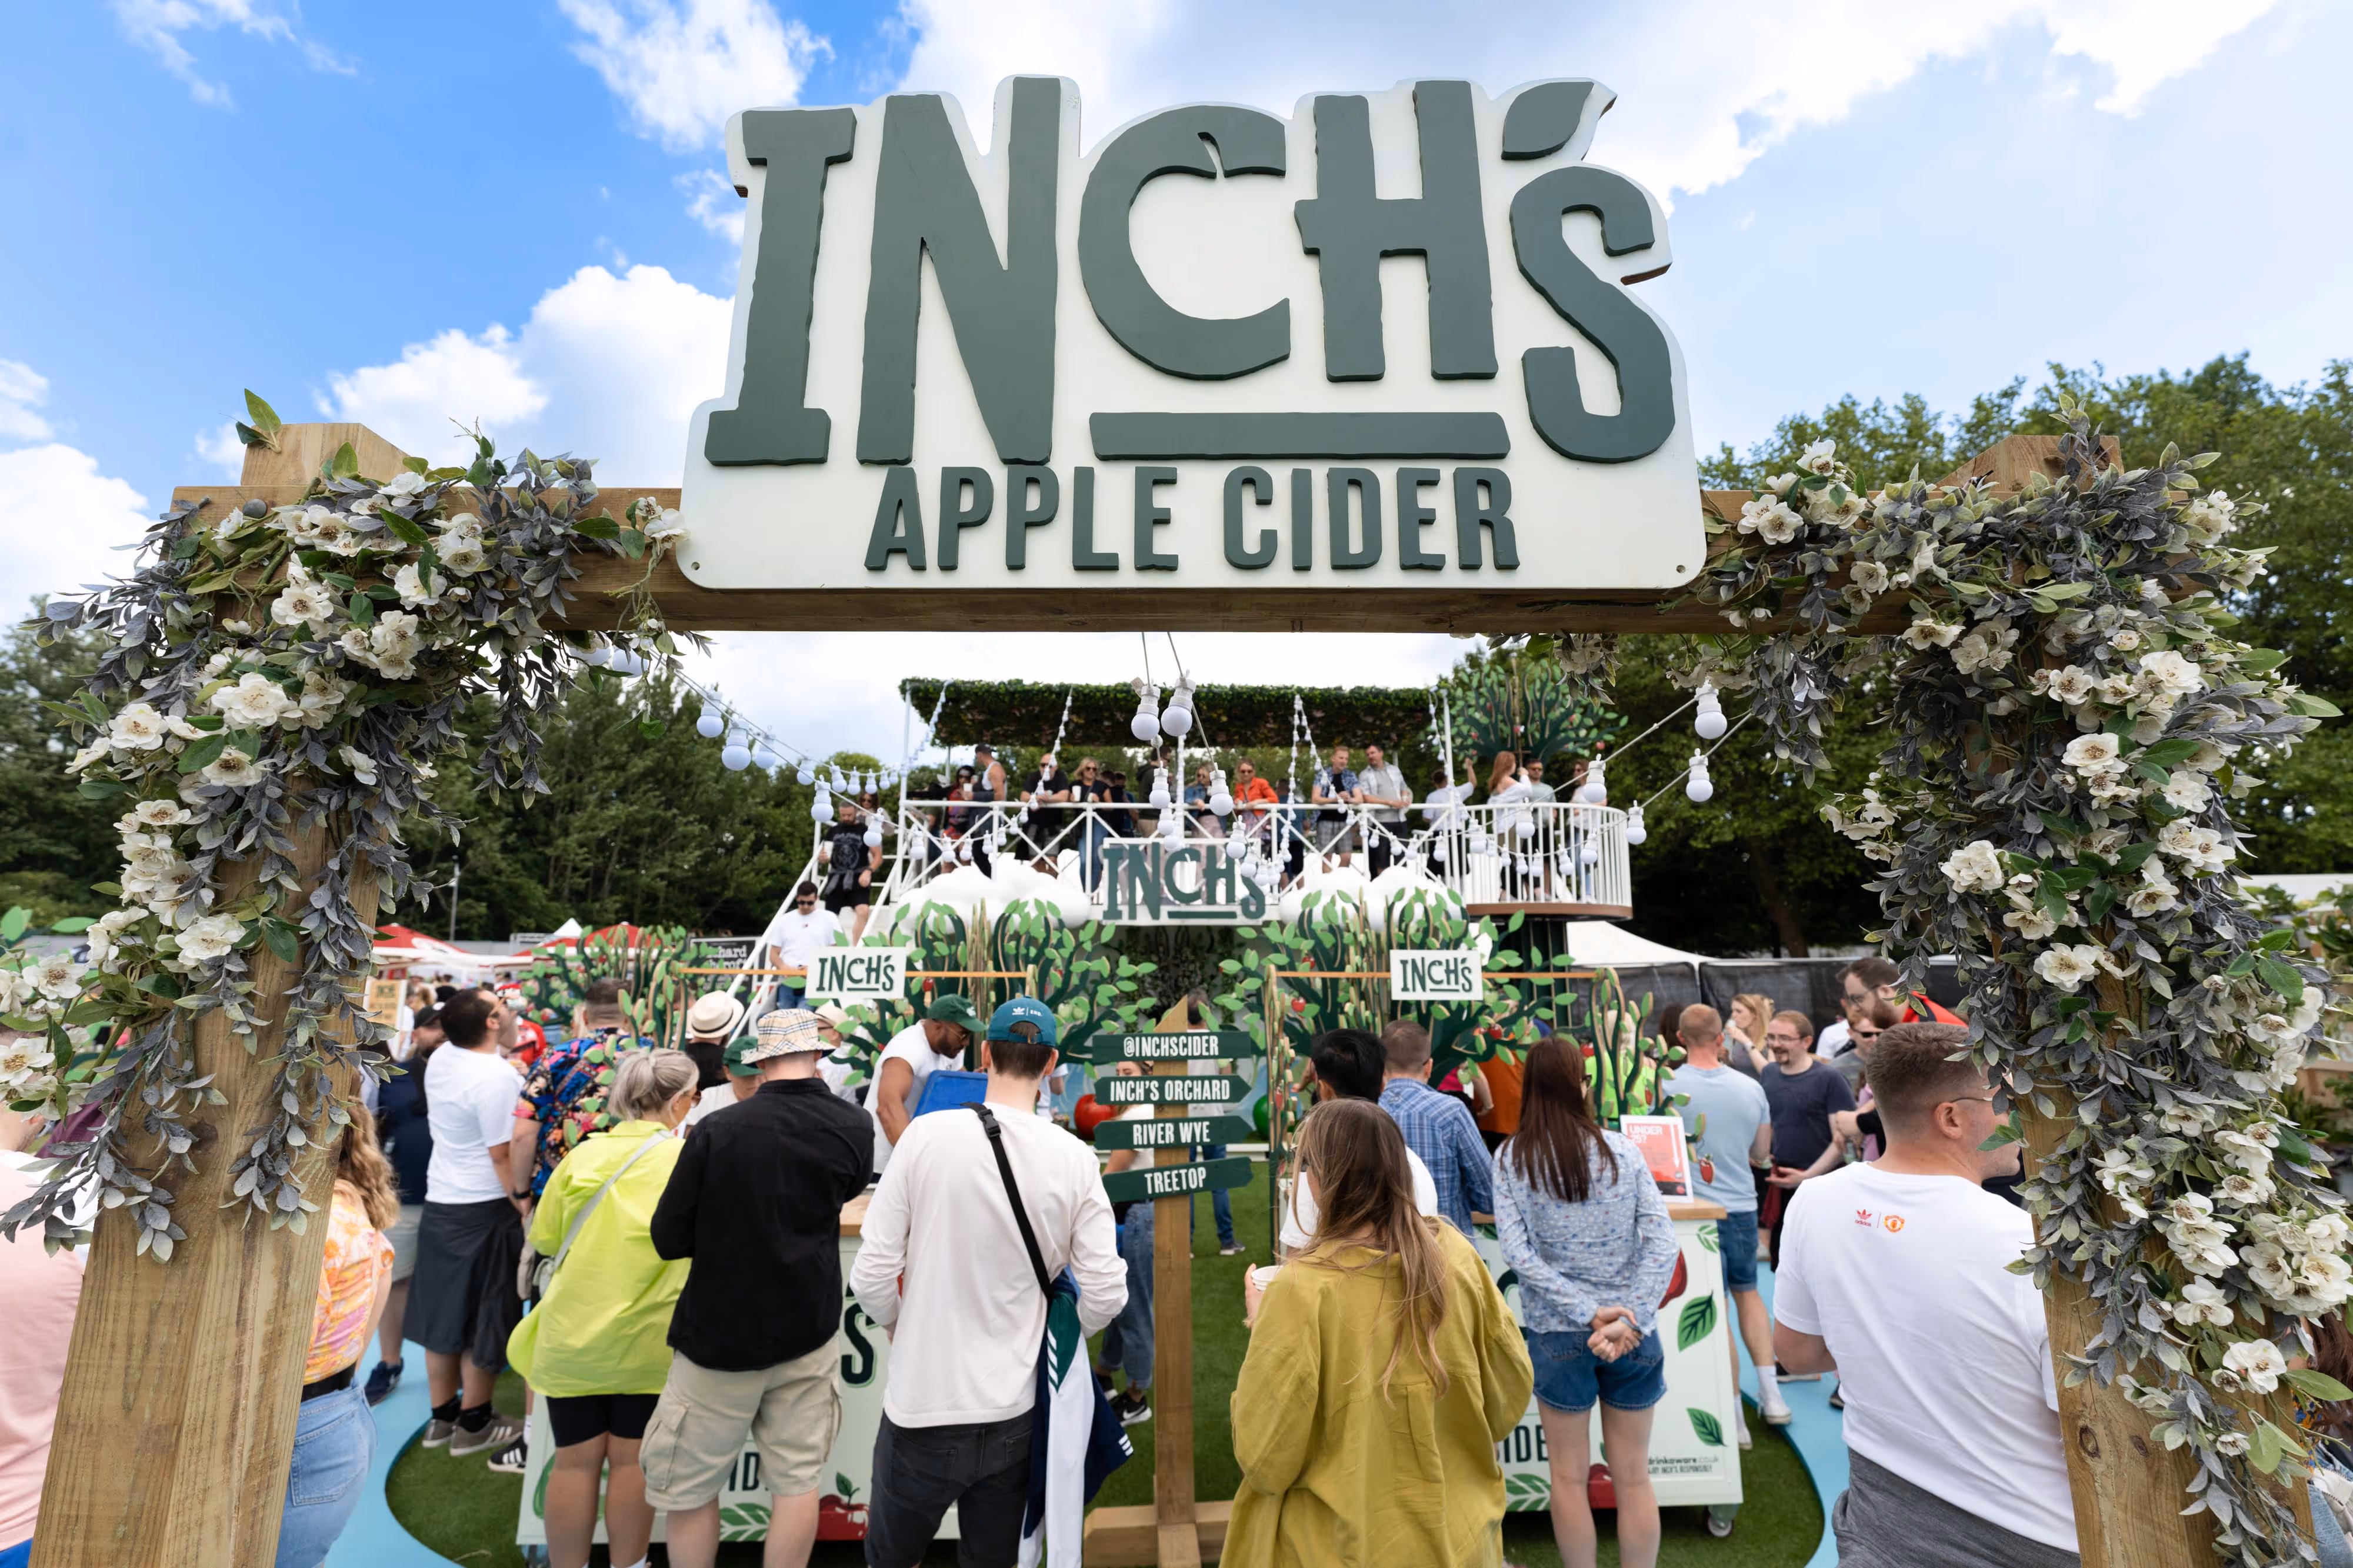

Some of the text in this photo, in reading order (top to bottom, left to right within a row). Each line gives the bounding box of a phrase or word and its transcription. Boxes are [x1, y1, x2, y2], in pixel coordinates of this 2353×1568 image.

[705, 75, 1676, 466] INCH'S
[864, 466, 1520, 571] APPLE CIDER
[816, 955, 895, 992] INCH'S
[1399, 957, 1472, 992] INCH'S
[1124, 1035, 1219, 1057] @INCHSCIDER
[1110, 1079, 1231, 1102] INCH'S ORCHARD
[1133, 1121, 1211, 1146] RIVER WYE
[1144, 1167, 1207, 1195] TREETOP
[1497, 1424, 1549, 1464] IDE
